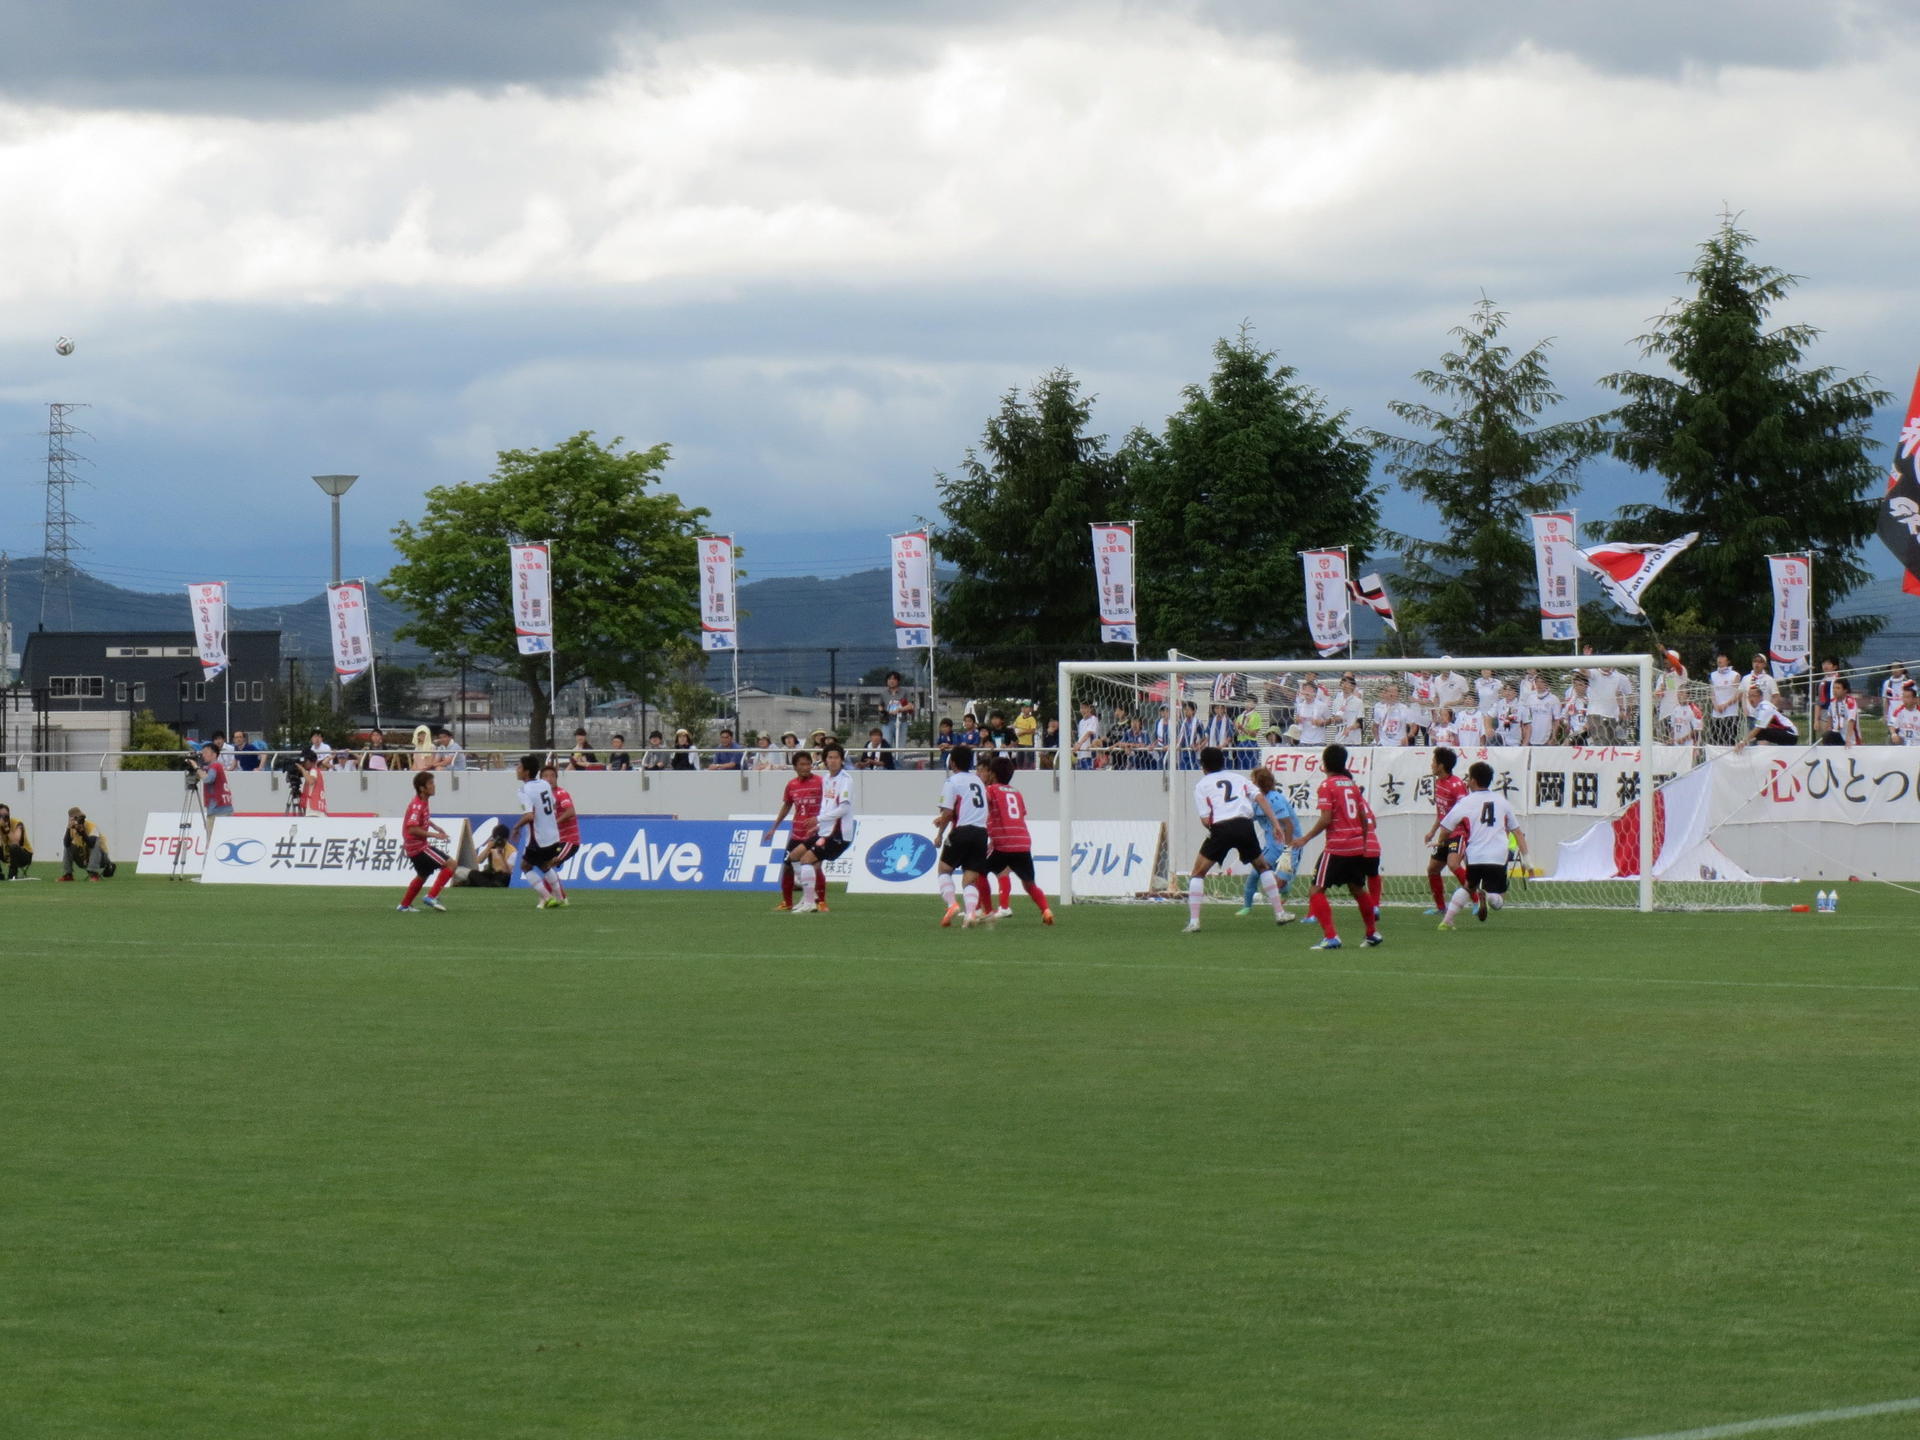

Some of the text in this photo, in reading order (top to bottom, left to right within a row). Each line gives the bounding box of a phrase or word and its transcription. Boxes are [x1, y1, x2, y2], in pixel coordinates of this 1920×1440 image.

[540, 790, 553, 816] 5
[969, 782, 985, 809] 3
[1216, 780, 1239, 803] 2
[1344, 788, 1358, 820] 6
[1006, 792, 1021, 820] 8
[1480, 801, 1497, 827] 4
[611, 828, 704, 882] Ave.
